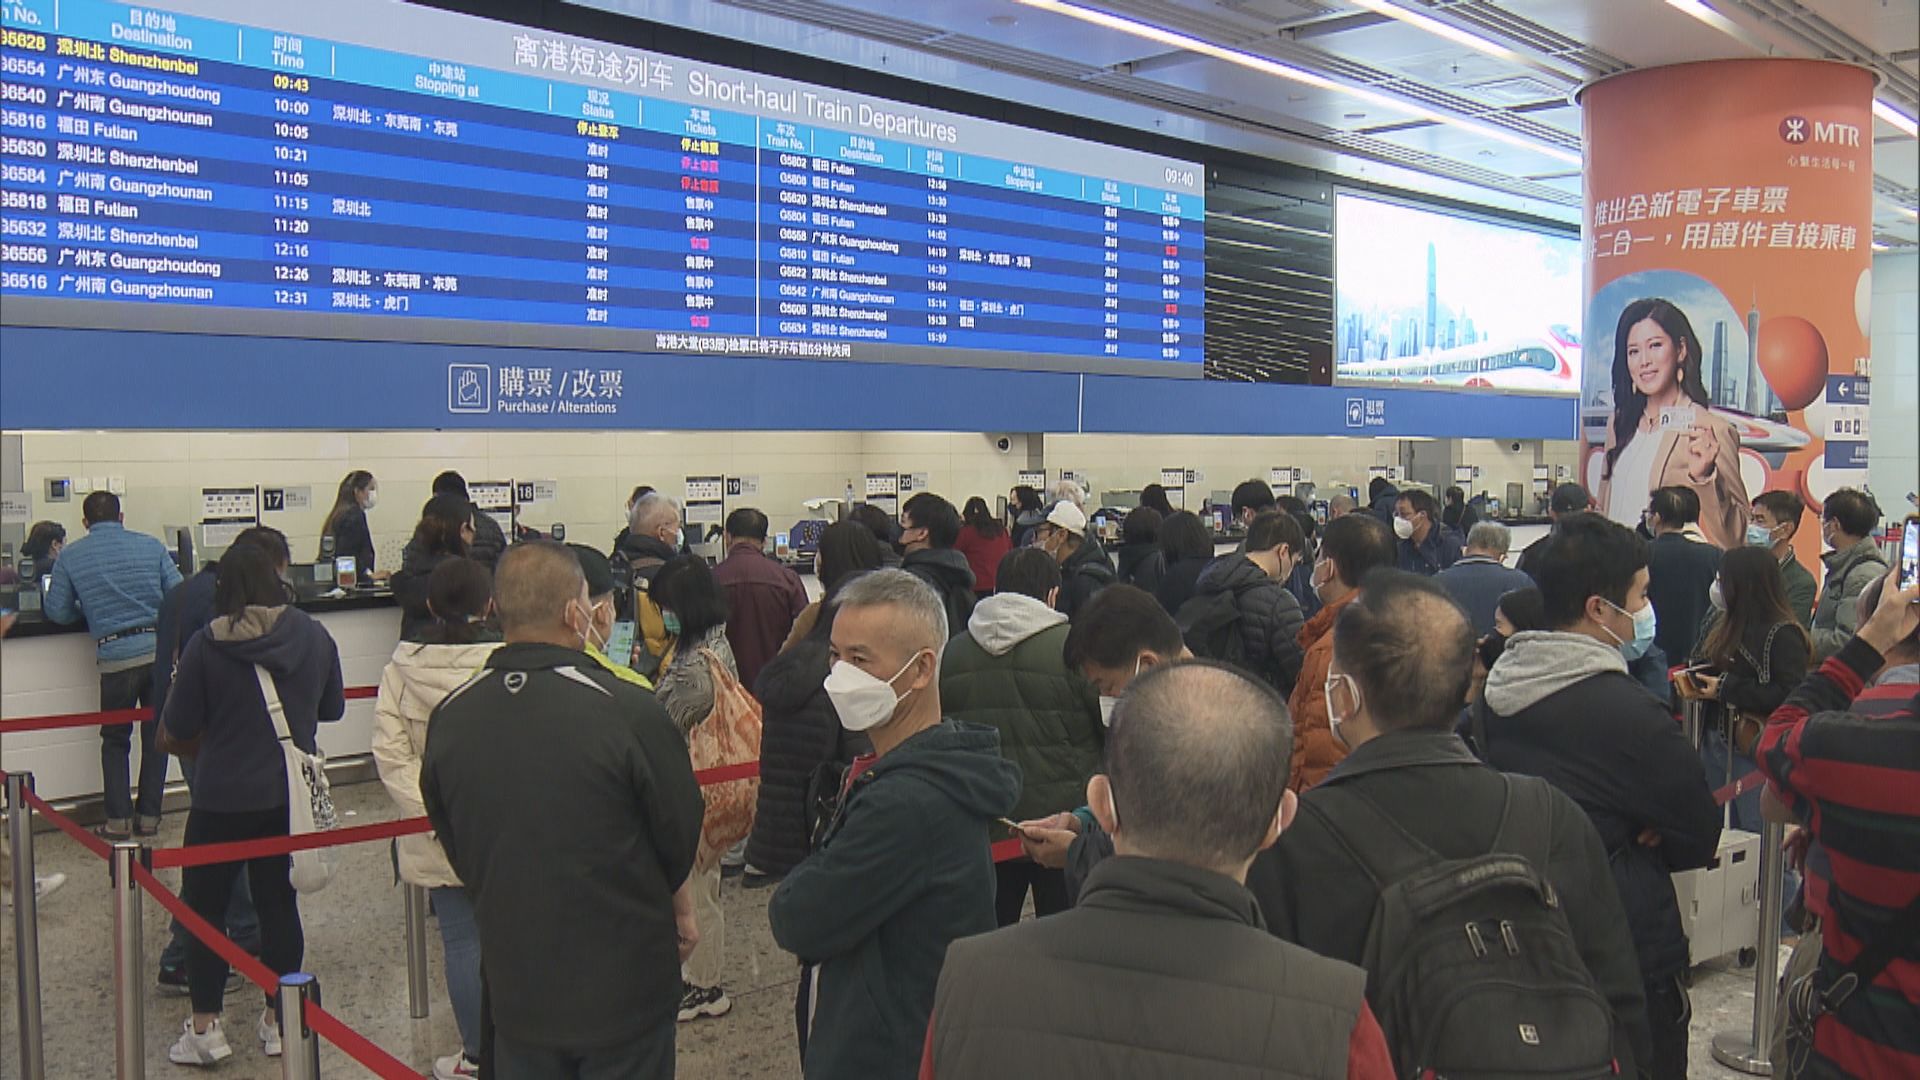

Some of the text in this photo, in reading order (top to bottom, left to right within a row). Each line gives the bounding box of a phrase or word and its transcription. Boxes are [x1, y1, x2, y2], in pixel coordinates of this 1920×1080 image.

[14, 6, 42, 25] No.
[130, 8, 177, 33] 目的地
[111, 22, 193, 51] Destination
[273, 35, 303, 54] 时间
[57, 38, 105, 60] 深圳北
[109, 47, 198, 74] Shenzhenbei
[274, 75, 308, 92] 09:43
[272, 51, 305, 70] Time
[428, 63, 466, 82] 中途站
[415, 76, 479, 98] Stopping at
[513, 33, 957, 143] 离港短途列车 Short-haul Train Departures
[57, 64, 105, 85] 广州东
[109, 73, 220, 105] Guangzhoudong
[275, 99, 308, 115] 10:00
[588, 143, 608, 158] 准时
[582, 102, 615, 120] Status
[57, 91, 105, 113] 广州南
[109, 98, 212, 126] Guangzhounan
[275, 123, 308, 139] 10:05
[587, 164, 608, 179] 准时
[684, 120, 717, 137] Tickets
[1815, 122, 1859, 147] MTR
[767, 134, 788, 149] Train
[57, 116, 88, 135] 福田
[94, 122, 137, 140] Futian
[275, 147, 306, 161] 10:21
[587, 184, 608, 199] 准时
[58, 142, 105, 163] 深圳北
[110, 150, 198, 174] Shenzhenbei
[275, 171, 308, 186] 11:05
[587, 205, 608, 219] 准时
[1165, 168, 1194, 187] 09:40
[58, 170, 105, 190] 广州南
[110, 176, 212, 200] Guangzhounan
[275, 195, 308, 209] 11:15
[333, 199, 371, 216] 深圳北
[587, 226, 608, 240] 准时
[1594, 186, 1789, 228] 推出全新電子車票
[58, 195, 89, 214] 福田
[95, 201, 137, 217] Futian
[275, 219, 308, 233] 11:20
[587, 246, 608, 261] 准时
[58, 222, 105, 241] 深圳北
[110, 228, 198, 248] Shenzhenbei
[275, 243, 308, 257] 12:16
[587, 267, 608, 281] 准时
[58, 248, 106, 267] 广州东
[110, 253, 220, 277] Guangzhoudong
[275, 266, 308, 281] 12:26
[587, 287, 608, 301] 准时
[59, 275, 106, 293] 广州南
[111, 279, 212, 298] Guangzhounan
[275, 291, 307, 304] 12:31
[587, 308, 608, 322] 准时
[499, 366, 624, 398] 購票/改票
[498, 400, 549, 413] Purchase
[558, 400, 617, 414] Alterations
[519, 486, 532, 500] 18
[727, 481, 739, 493] 19
[901, 477, 911, 488] 20
[265, 493, 281, 508] 17
